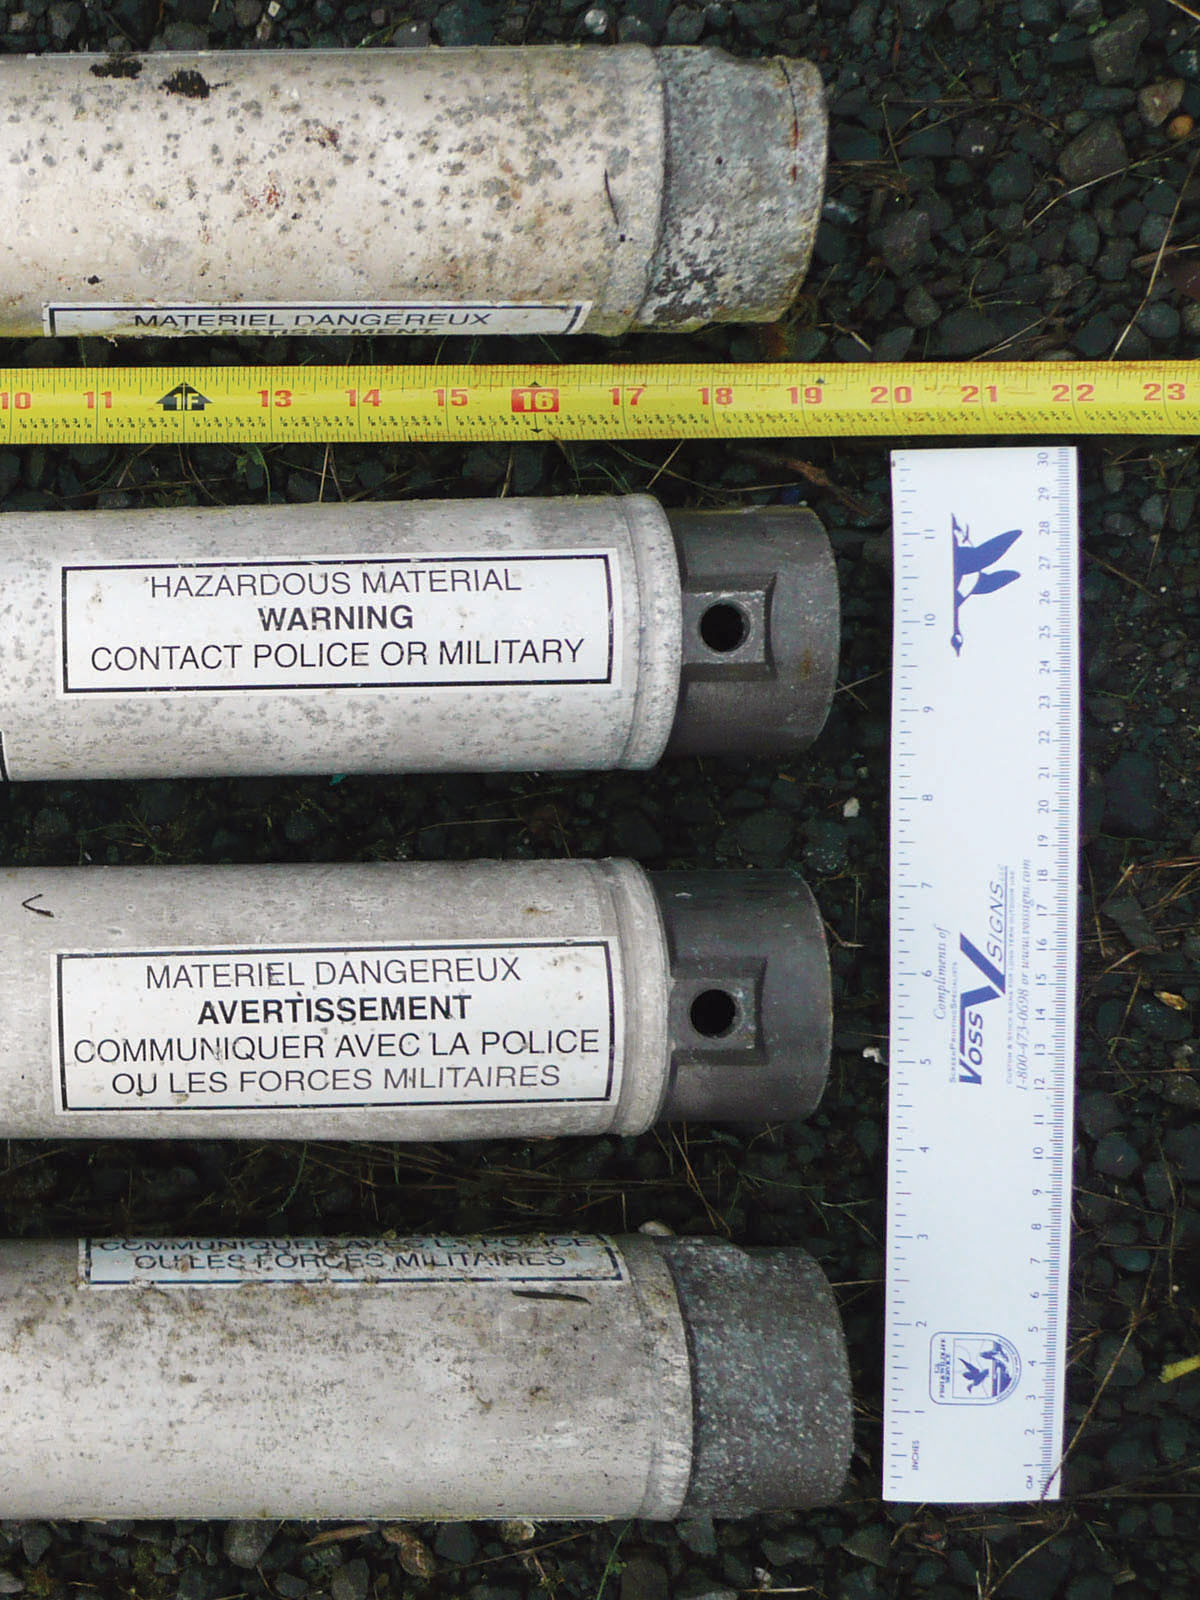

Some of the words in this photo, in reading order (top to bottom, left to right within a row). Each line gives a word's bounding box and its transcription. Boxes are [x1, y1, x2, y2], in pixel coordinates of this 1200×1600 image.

[134, 312, 285, 328] MATERIEL
[294, 312, 491, 326] DANGEREUX
[256, 389, 292, 407] 13
[344, 389, 382, 407] 14
[433, 388, 469, 407] 15
[608, 387, 644, 406] 17
[698, 387, 733, 405] 18
[786, 386, 823, 405] 19
[870, 386, 913, 404] 20
[961, 385, 997, 403] 21
[1051, 384, 1095, 402] 22
[1143, 383, 1186, 401] 23
[82, 391, 112, 408] 11
[173, 393, 199, 410] 1F
[519, 391, 554, 410] 16
[1038, 452, 1048, 464] 30
[1039, 487, 1049, 501] 29
[924, 529, 935, 540] 11
[1039, 521, 1049, 535] 28
[1039, 556, 1050, 570] 27
[150, 572, 351, 598] HAZARDOUS
[361, 568, 522, 595] MATERIAL
[1039, 590, 1050, 604] 26
[258, 605, 414, 631] WARNING
[924, 613, 935, 627] 10
[1039, 625, 1050, 639] 25
[91, 644, 243, 671] CONTACT
[253, 642, 370, 668] POLICE
[381, 640, 428, 667] OR
[440, 637, 585, 664] MILITARY
[1040, 660, 1050, 674] 24
[1040, 696, 1050, 709] 23
[1039, 730, 1049, 744] 22
[1039, 767, 1049, 779] 21
[1038, 800, 1049, 813] 20
[1038, 835, 1048, 847] 19
[1038, 869, 1048, 882] 18
[1037, 904, 1047, 917] 17
[987, 881, 1004, 962] SIGNS
[934, 923, 949, 938] of
[1036, 939, 1047, 951] 16
[146, 962, 305, 990] MATERIEL
[316, 957, 522, 986] DANGEREUX
[1021, 973, 1030, 985] or
[1036, 974, 1046, 986] 15
[933, 942, 950, 1020] Compliments
[197, 995, 473, 1025] AVERTISSEMENT
[1035, 1008, 1046, 1021] 14
[73, 1034, 324, 1064] COMMUNIQUER
[334, 1032, 420, 1058] AVEC
[430, 1031, 469, 1056] LA
[481, 1029, 600, 1055] POLICE
[959, 1011, 983, 1085] VOSS
[1035, 1044, 1045, 1055] 13
[111, 1072, 158, 1096] OU
[168, 1071, 228, 1095] LES
[240, 1068, 373, 1093] FORCES
[384, 1064, 561, 1090] MILITAIRES
[1034, 1079, 1045, 1090] 12
[1033, 1115, 1044, 1125] 11
[1033, 1147, 1043, 1160] 10
[1026, 1475, 1033, 1489] CM
